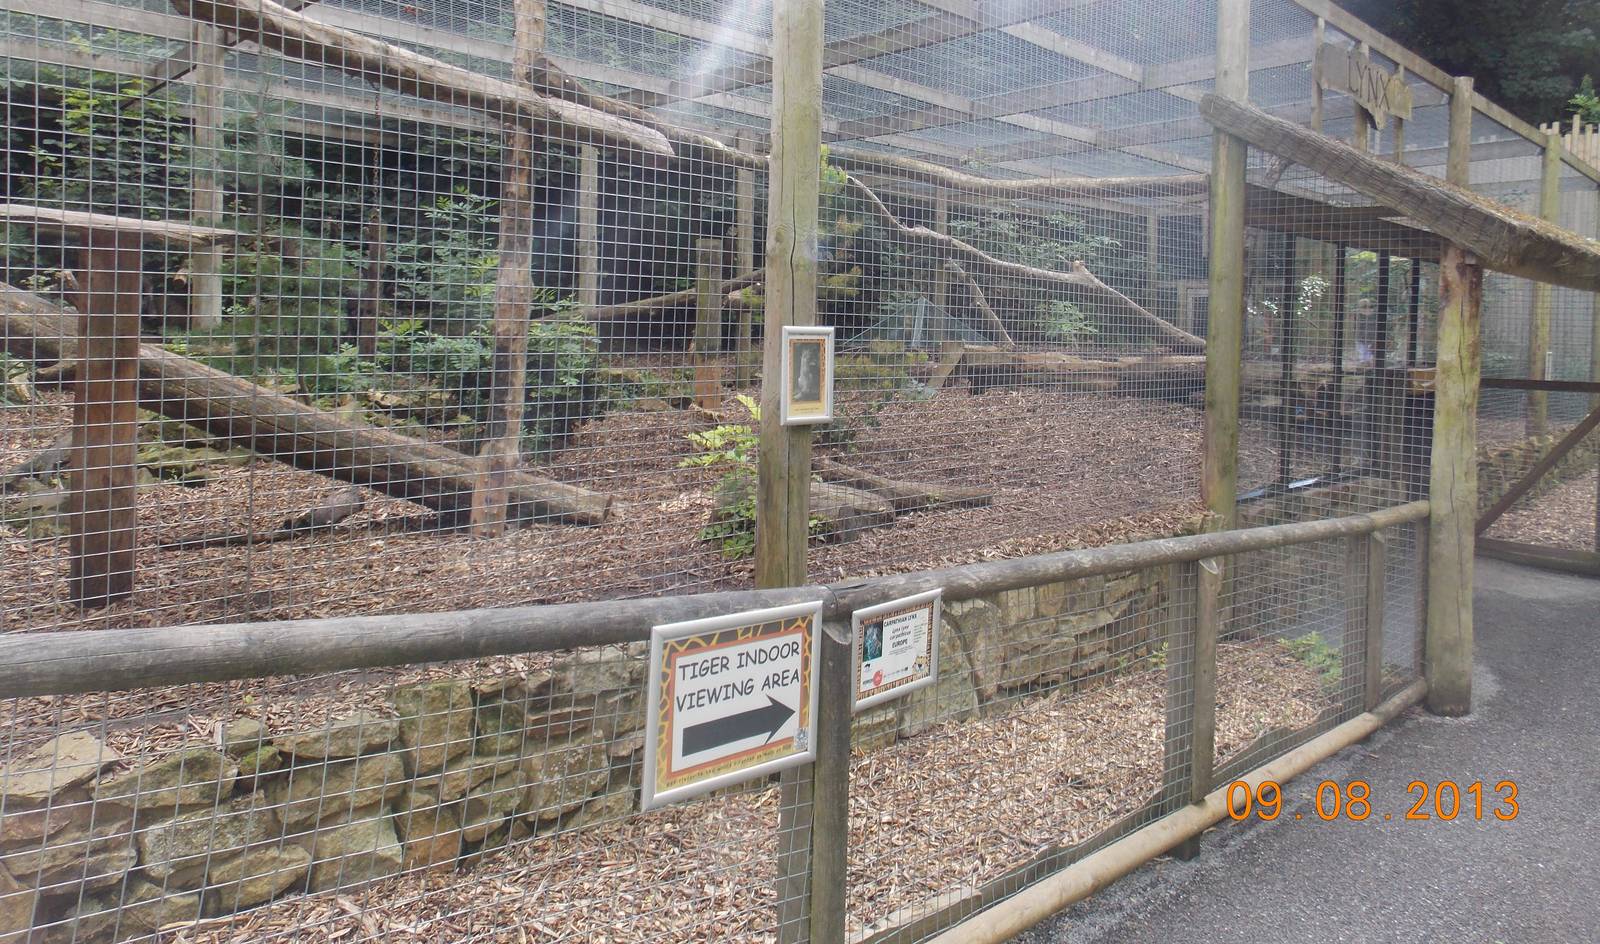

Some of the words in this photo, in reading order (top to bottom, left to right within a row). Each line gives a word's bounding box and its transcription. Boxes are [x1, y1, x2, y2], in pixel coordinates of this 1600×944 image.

[1347, 55, 1391, 111] LYNX
[678, 655, 730, 681] TIGER
[736, 641, 800, 669] INDOOR
[892, 639, 908, 649] EUROPE
[676, 678, 755, 713] VIEWING
[761, 668, 800, 691] AREA
